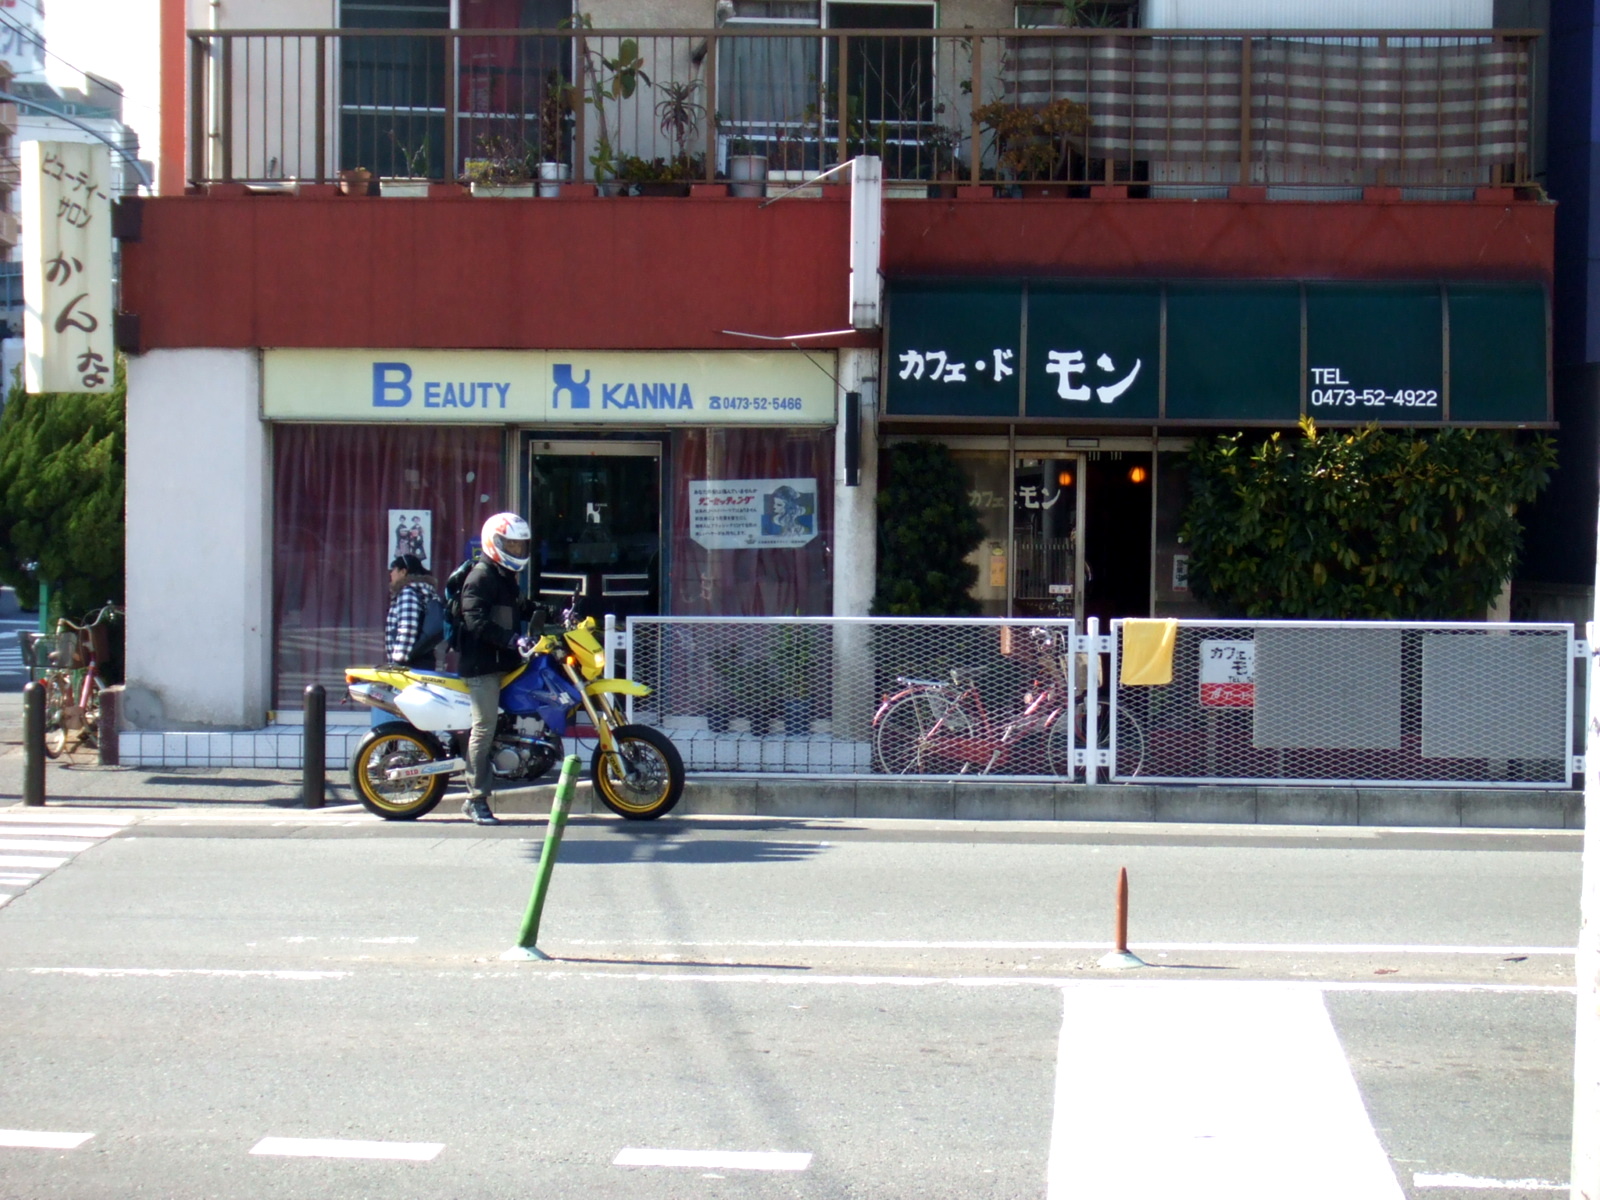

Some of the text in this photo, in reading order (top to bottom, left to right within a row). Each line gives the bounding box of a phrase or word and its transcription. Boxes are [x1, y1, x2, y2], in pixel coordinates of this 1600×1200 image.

[57, 196, 93, 228] サロン
[45, 250, 110, 389] かんな
[1046, 350, 1141, 404] モン
[1311, 368, 1350, 385] TEL
[602, 383, 694, 410] KANNA
[1311, 389, 1438, 407] 0473-52-4922
[1019, 486, 1061, 510] モン
[420, 676, 447, 685] SUZUKI
